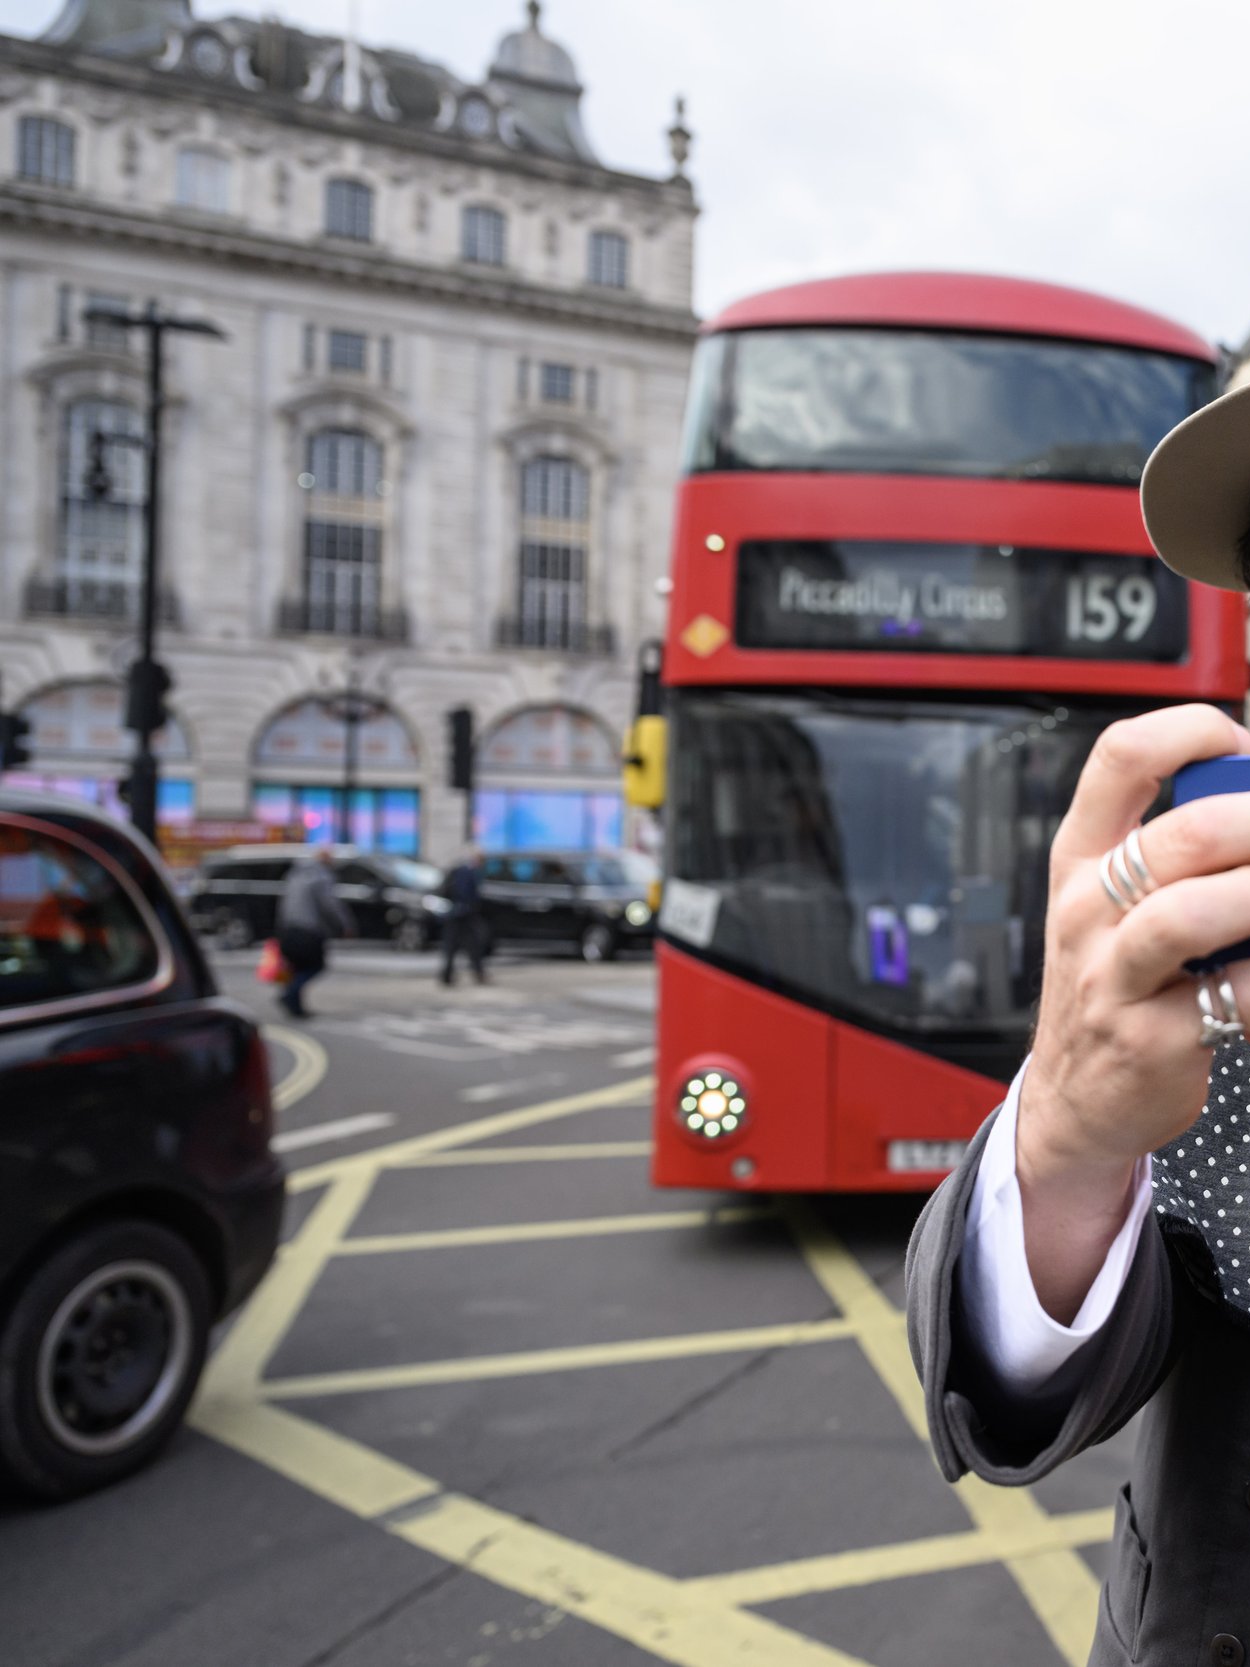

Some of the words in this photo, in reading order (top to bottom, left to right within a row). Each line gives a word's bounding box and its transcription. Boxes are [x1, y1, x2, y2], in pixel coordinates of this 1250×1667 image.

[779, 566, 914, 626] Piccadilly
[921, 573, 1008, 620] Circus
[1067, 574, 1157, 642] 159
